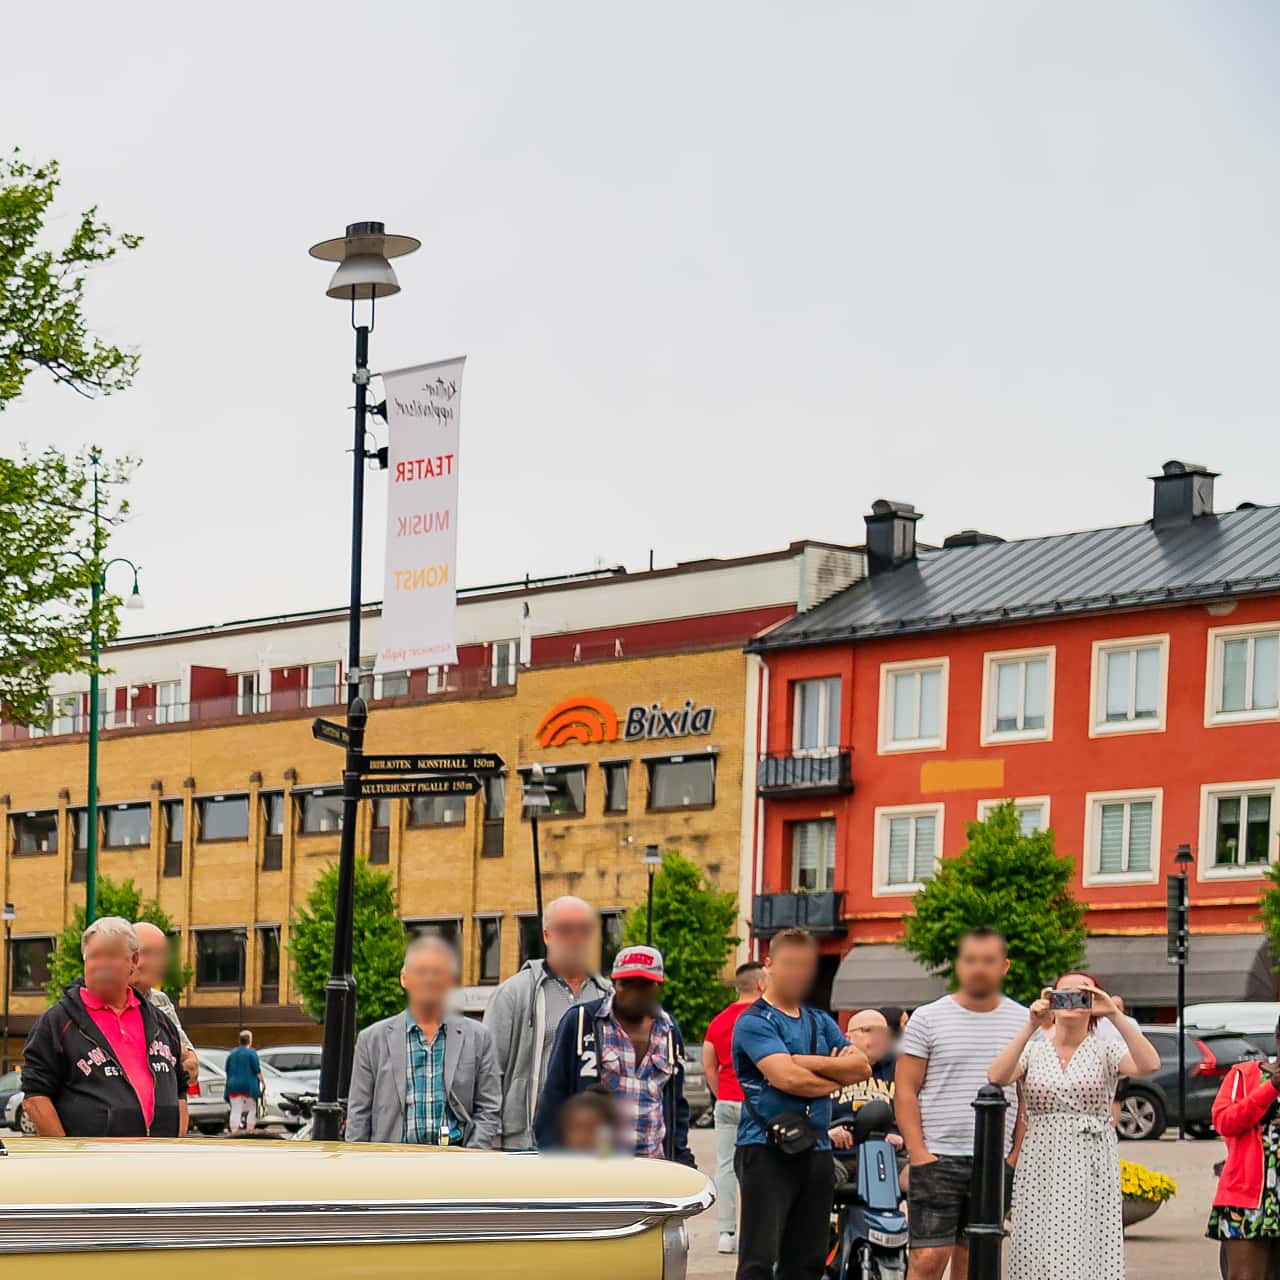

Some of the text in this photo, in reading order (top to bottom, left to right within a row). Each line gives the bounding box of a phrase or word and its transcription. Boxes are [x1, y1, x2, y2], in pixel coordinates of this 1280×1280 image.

[624, 698, 715, 741] Bixia
[417, 759, 468, 769] KONSTHALL
[361, 783, 417, 794] KULTURHUSET
